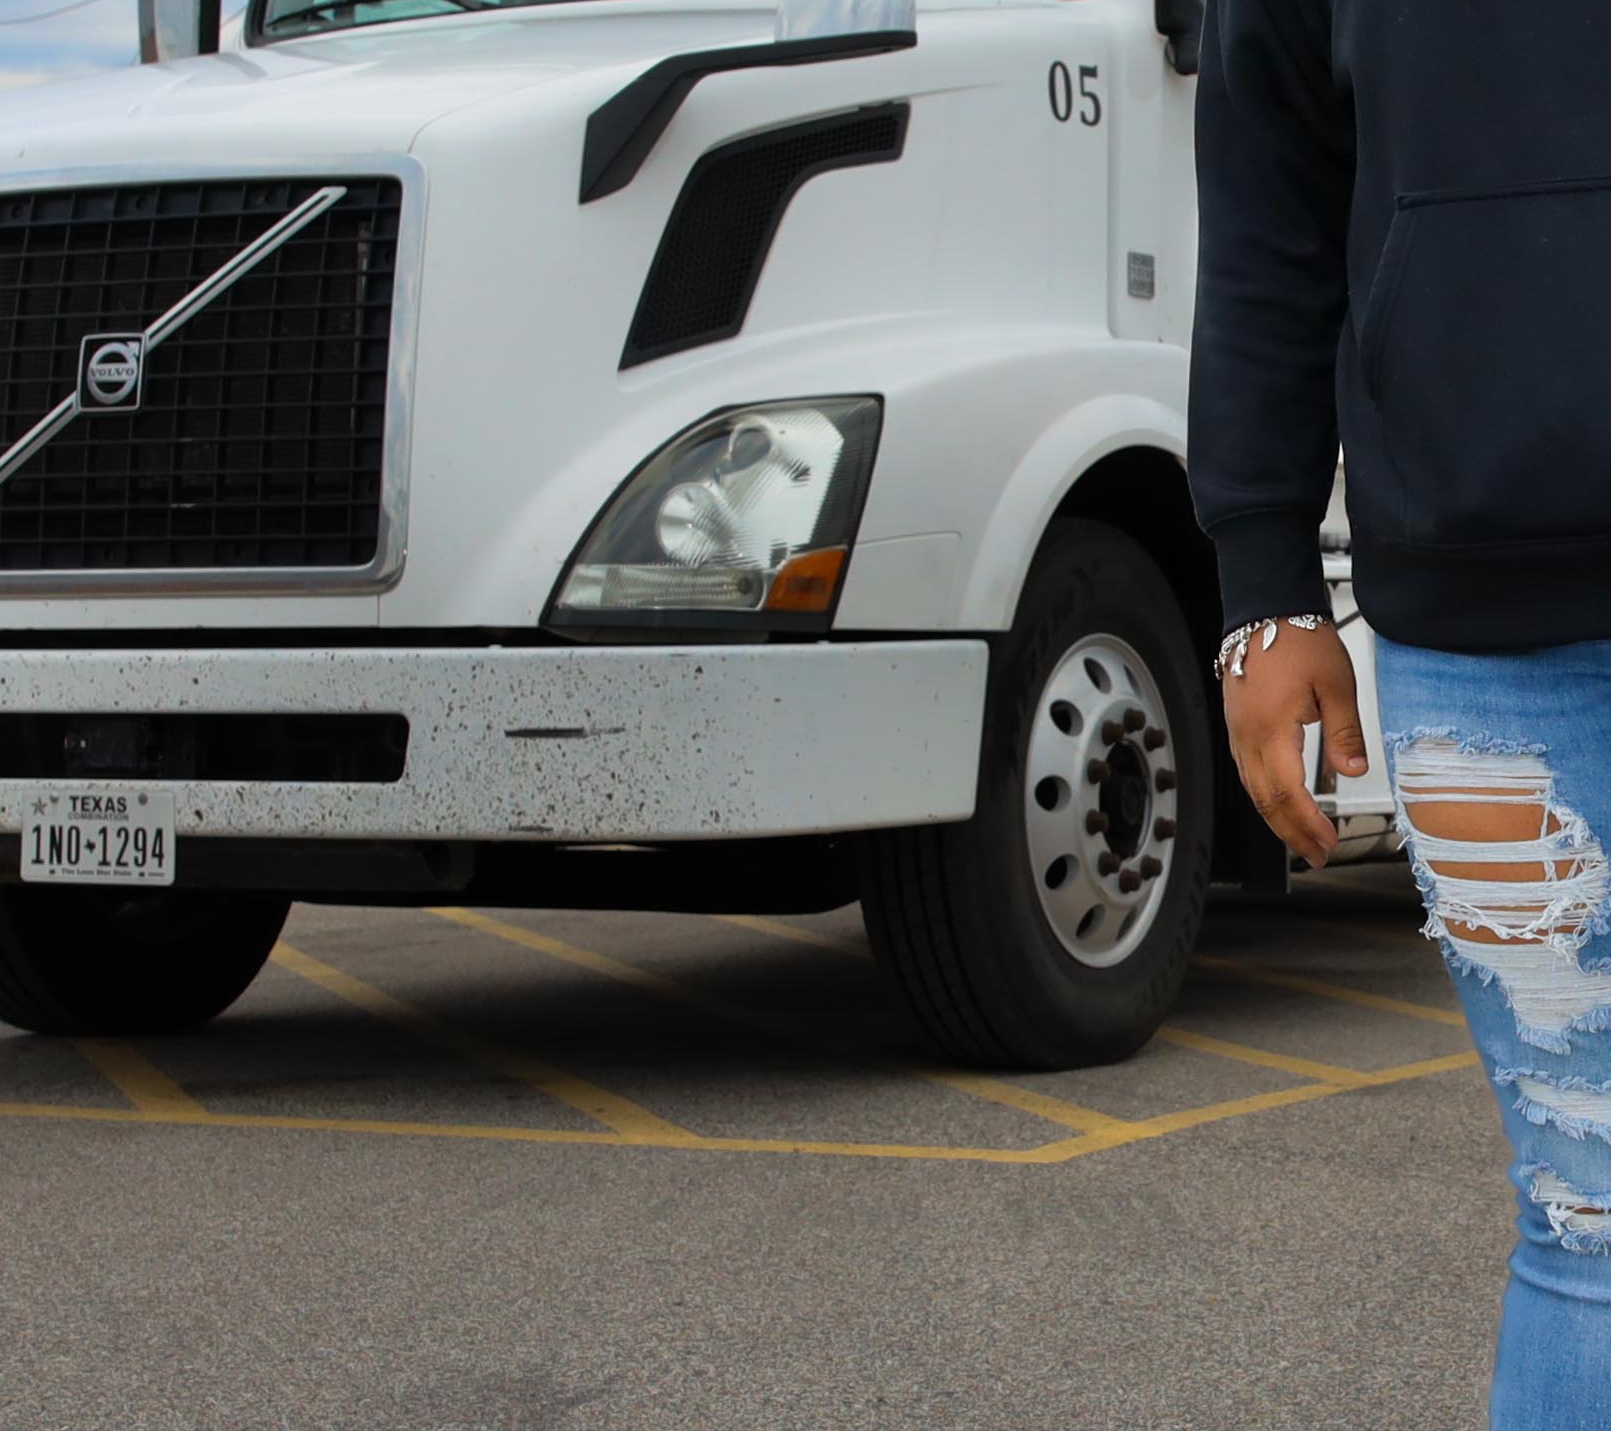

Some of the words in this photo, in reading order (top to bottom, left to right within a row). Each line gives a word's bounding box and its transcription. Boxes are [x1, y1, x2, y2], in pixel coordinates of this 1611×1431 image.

[1047, 60, 1102, 127] 05
[90, 368, 135, 377] VOLVO
[69, 795, 128, 814] TEXAS
[67, 812, 130, 822] COMBINATION
